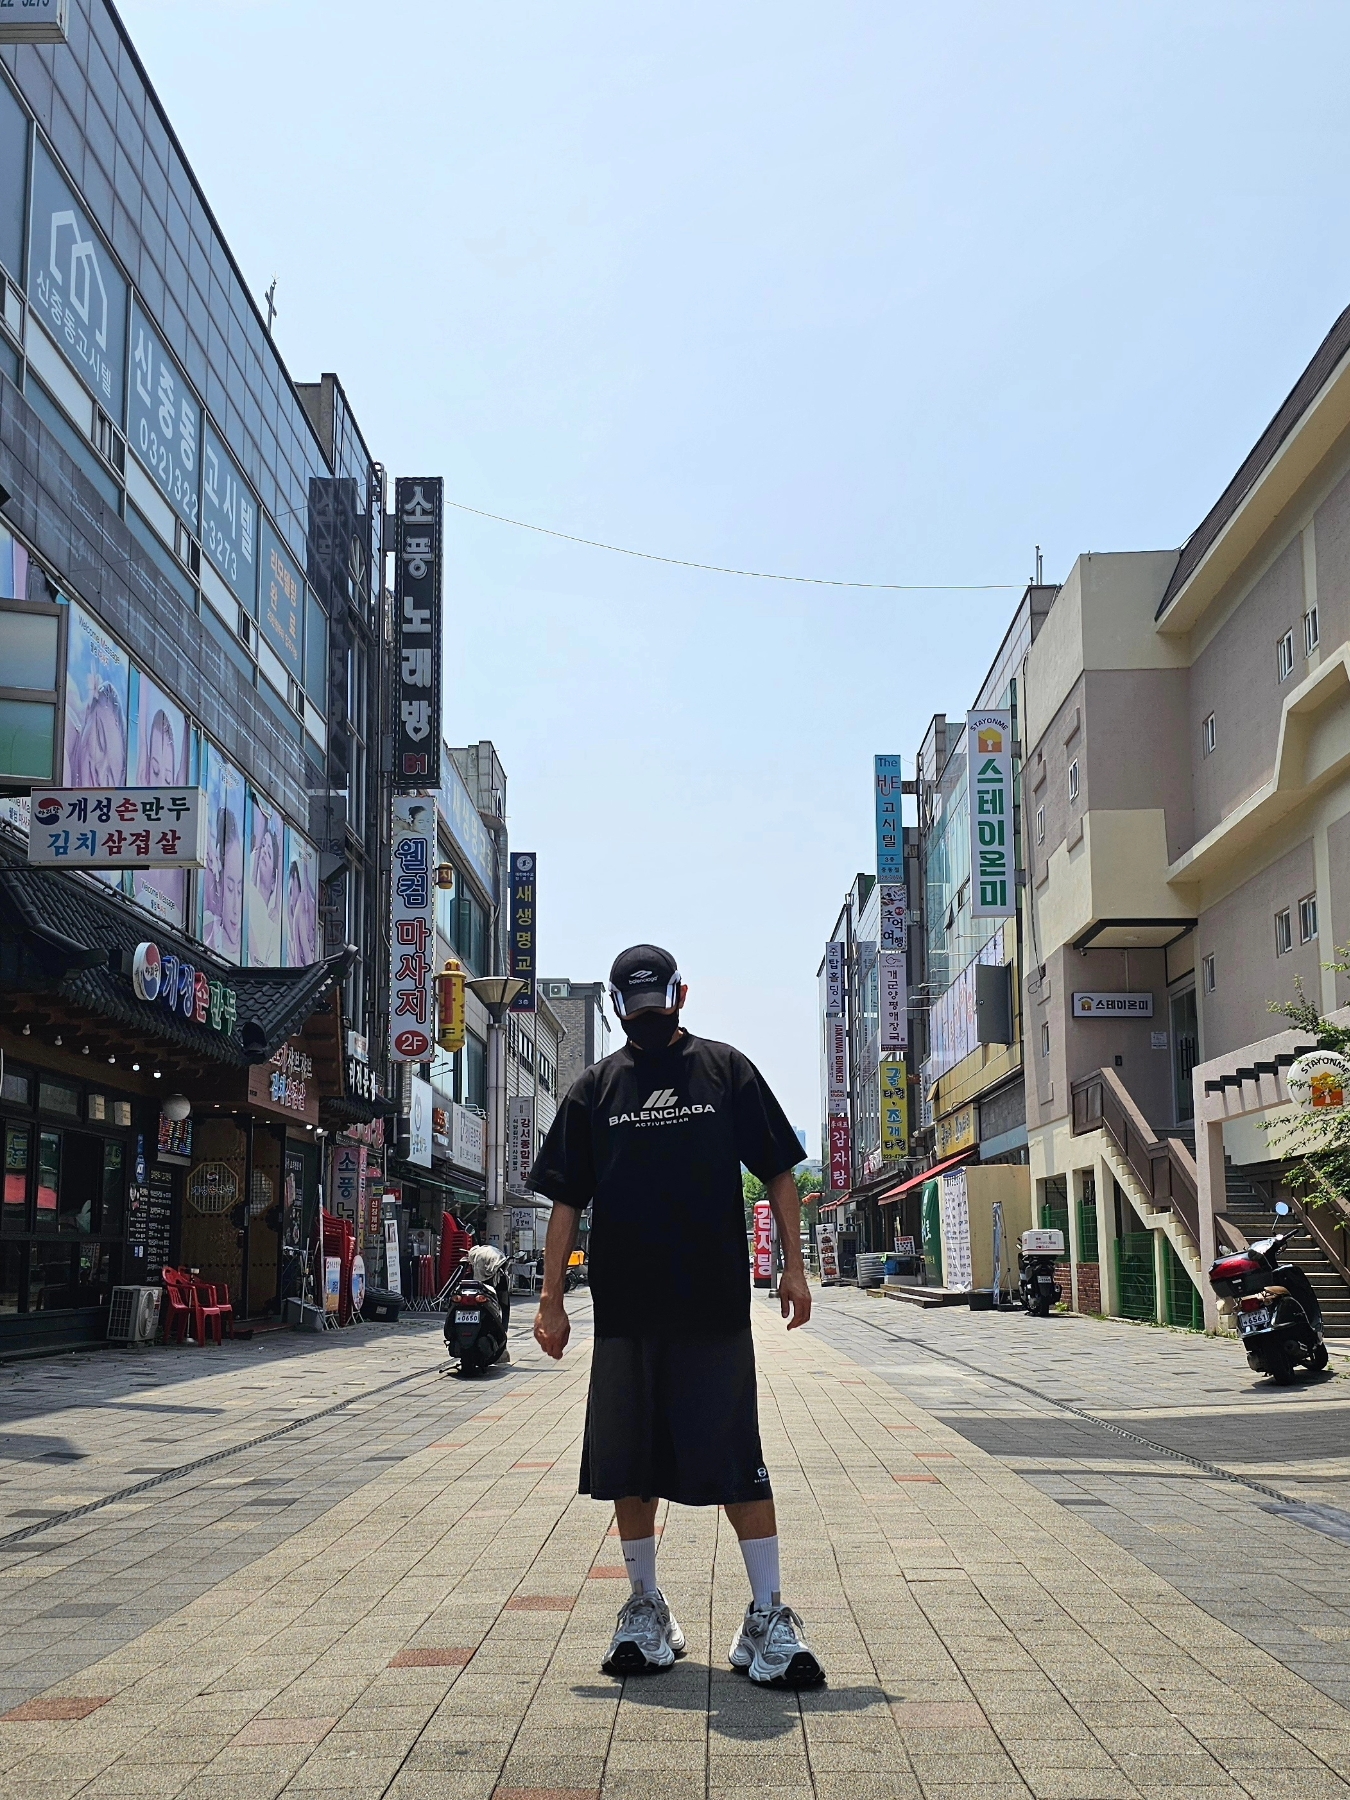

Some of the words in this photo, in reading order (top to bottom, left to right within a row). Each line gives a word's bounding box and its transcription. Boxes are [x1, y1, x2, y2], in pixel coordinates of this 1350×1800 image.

[969, 717, 1009, 732] STAYONME
[878, 758, 898, 768] The
[66, 797, 190, 824] 개성손만두
[882, 802, 896, 848] 고시텔
[977, 758, 1007, 906] 스테이온미
[47, 829, 182, 857] 김치삼겹살
[395, 837, 428, 909] 웰컴
[396, 917, 432, 1025] 마사지
[628, 976, 659, 985] balenciaga
[162, 956, 237, 1037] 개성손만두
[1095, 999, 1149, 1010] 스테이온미
[401, 1033, 423, 1050] 2F
[1301, 1056, 1350, 1075] STAYONME
[608, 1103, 716, 1127] BALENCIAGA
[635, 1117, 690, 1128] ACTIVEWEAR
[832, 1129, 848, 1187] 감자탕
[1247, 1314, 1268, 1324] 6561
